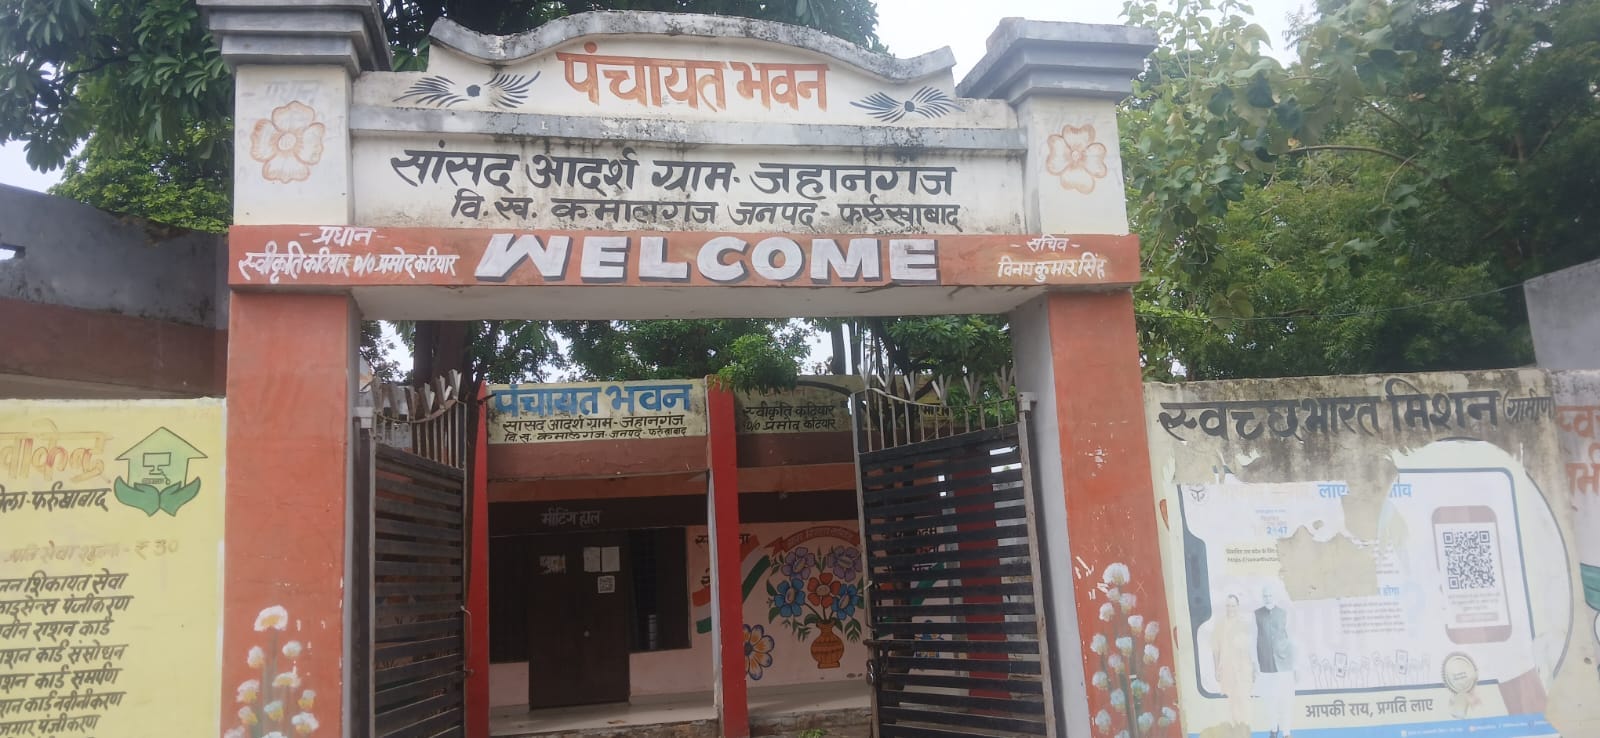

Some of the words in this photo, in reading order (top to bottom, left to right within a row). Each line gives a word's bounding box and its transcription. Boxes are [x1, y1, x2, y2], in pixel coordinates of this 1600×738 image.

[556, 42, 726, 111] पंचायत
[729, 61, 829, 110] भवन
[391, 140, 520, 193] सांसद
[526, 147, 640, 196] आदर्श
[475, 232, 940, 283] WELCOME
[492, 384, 601, 417] पंचायत
[605, 384, 693, 412] भवन
[1158, 400, 1303, 441] स्वच्छ
[1302, 395, 1382, 437] भारत
[1386, 377, 1500, 434] मिशन
[503, 417, 545, 432] सांसद
[547, 415, 584, 432] आदर्श
[24, 570, 93, 597] शिकायत
[92, 568, 129, 594] सेवा
[62, 593, 134, 617] पंजीकरण
[33, 621, 80, 642] राशन
[79, 616, 114, 636] कार्ड
[36, 639, 69, 663] कार्ड
[35, 664, 71, 688] कार्ड
[1305, 699, 1346, 718] आपकी
[1376, 697, 1408, 715] प्रगति
[38, 712, 101, 734] पंजीकरण
